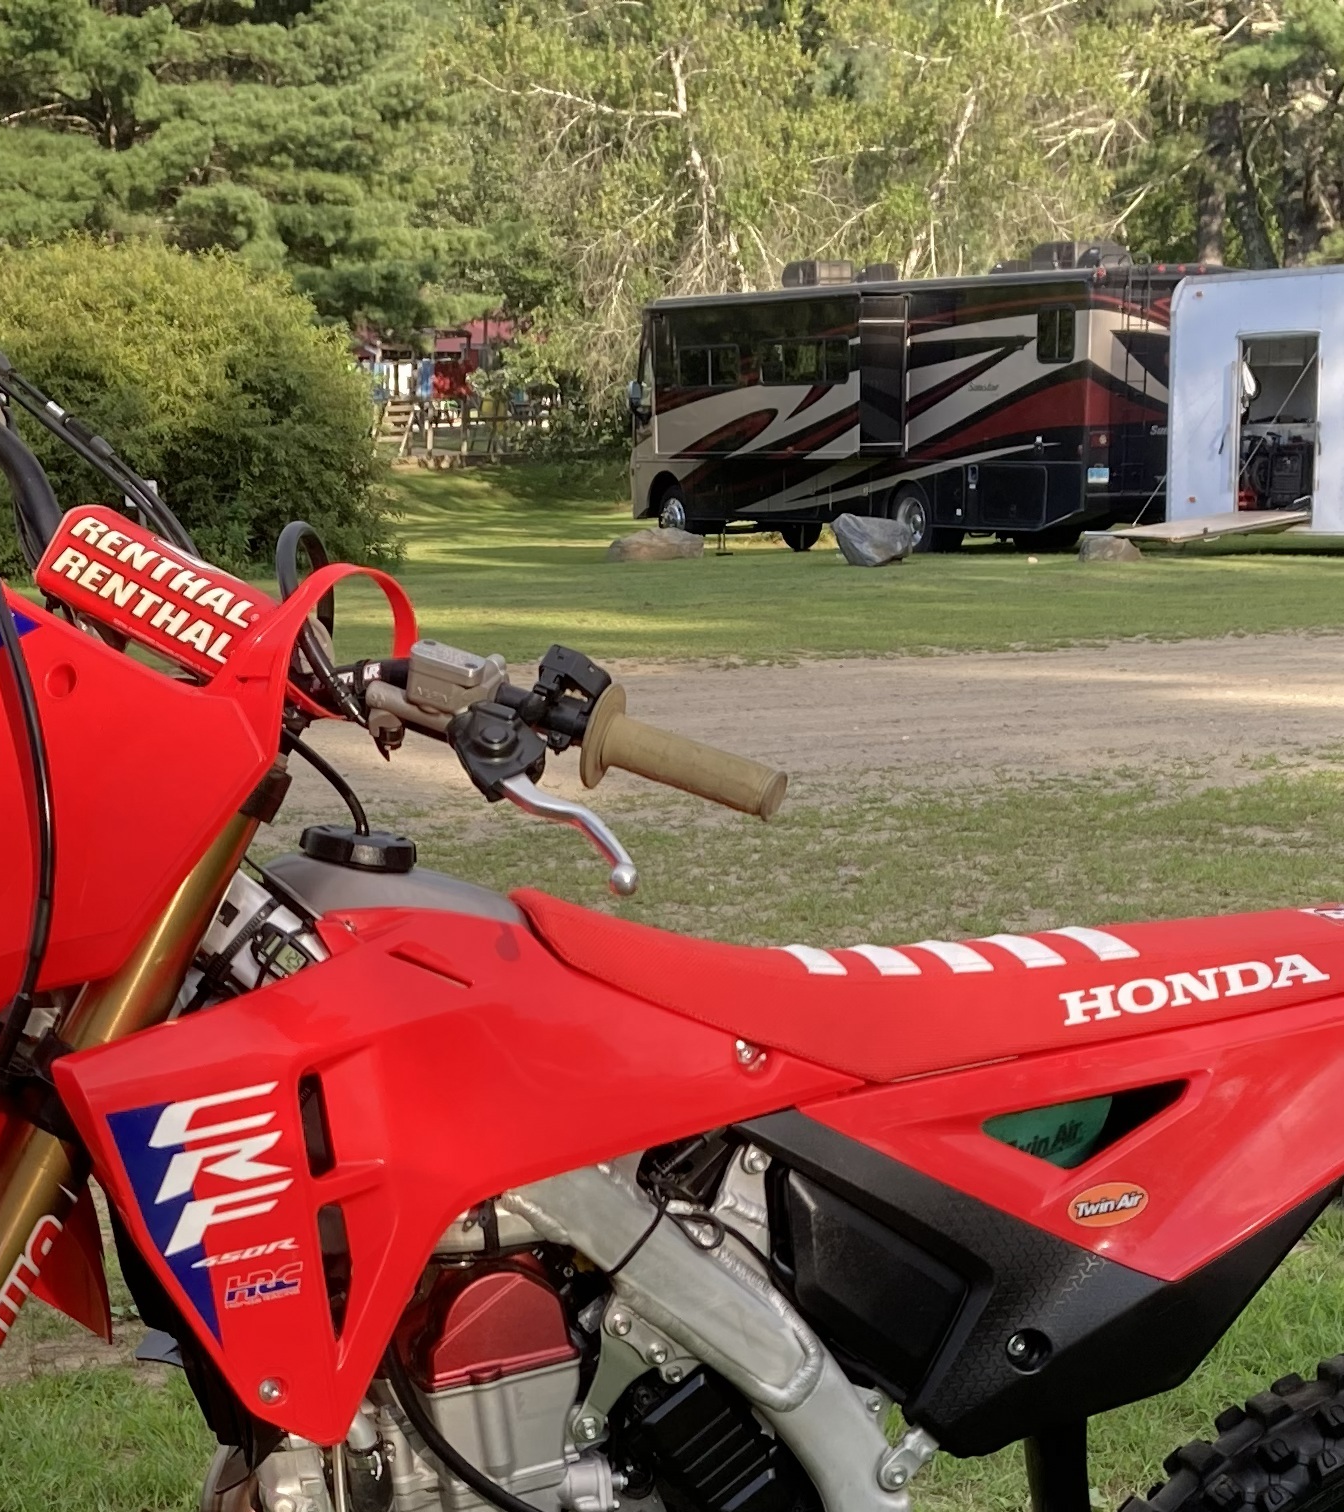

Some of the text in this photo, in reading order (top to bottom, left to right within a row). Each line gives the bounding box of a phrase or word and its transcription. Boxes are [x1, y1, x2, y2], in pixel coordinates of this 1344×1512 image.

[51, 546, 233, 665] RENTHAL
[69, 516, 255, 629] RENTHAL
[1058, 953, 1331, 1027] HONDA
[148, 1080, 295, 1258] CRF
[1075, 1191, 1145, 1219] Twin Air
[191, 1237, 300, 1269] 450R
[224, 1261, 304, 1305] HRC
